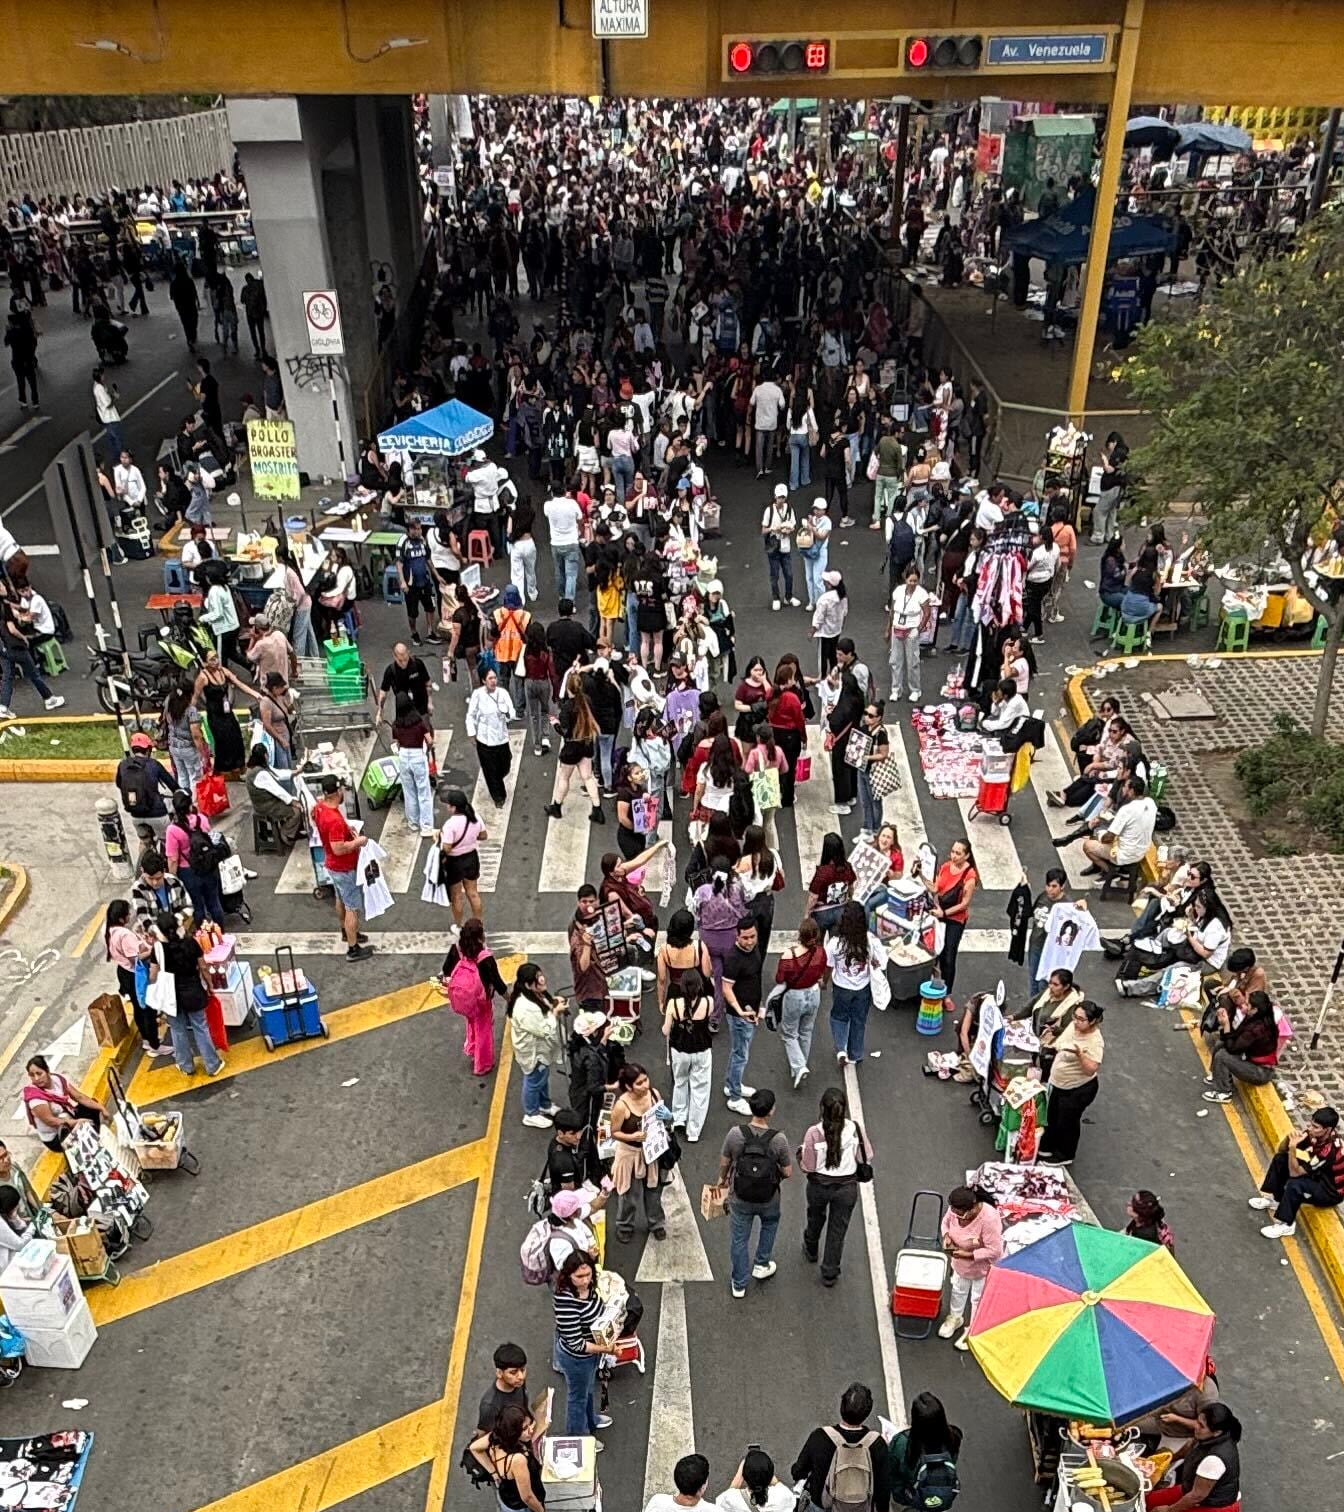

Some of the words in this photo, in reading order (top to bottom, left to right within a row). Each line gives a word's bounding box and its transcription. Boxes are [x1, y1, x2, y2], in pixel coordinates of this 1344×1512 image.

[599, 0, 641, 13] ALTURA
[1001, 45, 1018, 58] Av.
[1028, 42, 1091, 58] Venezuela
[250, 429, 289, 443] POLLO
[378, 435, 452, 450] CEVICHERIA
[250, 445, 297, 458] BROASTER
